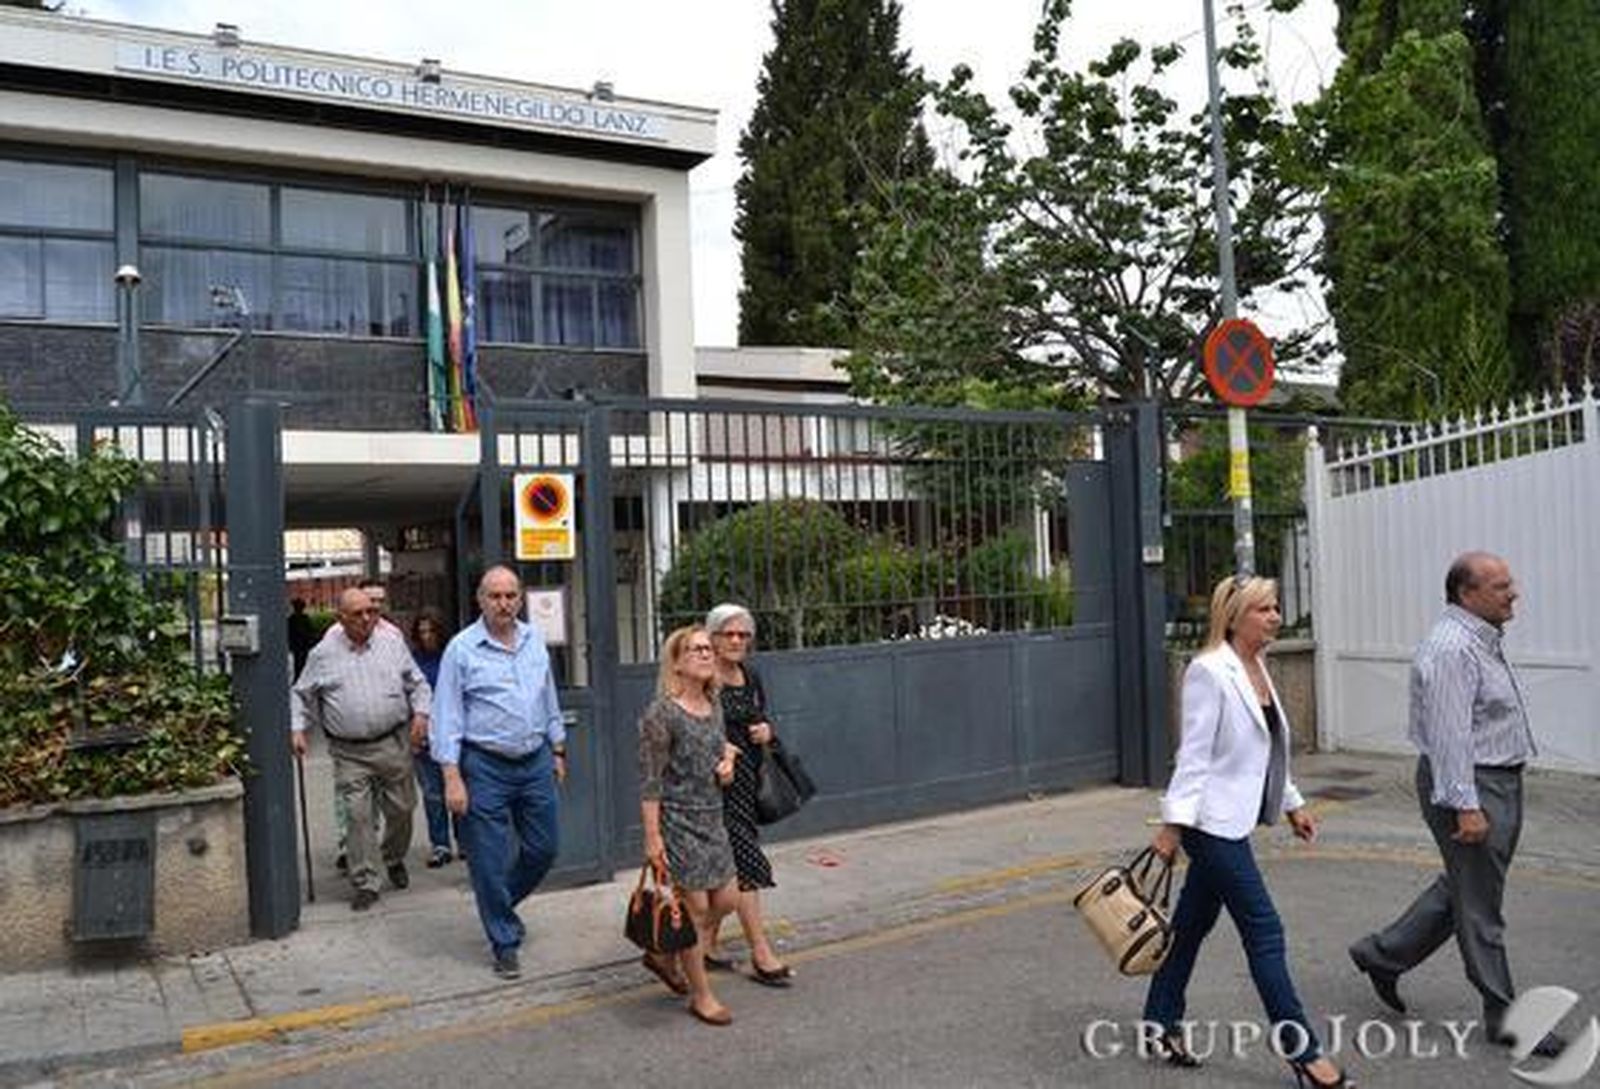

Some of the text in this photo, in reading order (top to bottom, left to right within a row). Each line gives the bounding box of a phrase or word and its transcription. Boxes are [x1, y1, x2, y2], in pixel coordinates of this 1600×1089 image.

[222, 56, 393, 98] POLITECNICO
[402, 83, 584, 125] HERMENEGILDO
[593, 110, 647, 134] LANZ
